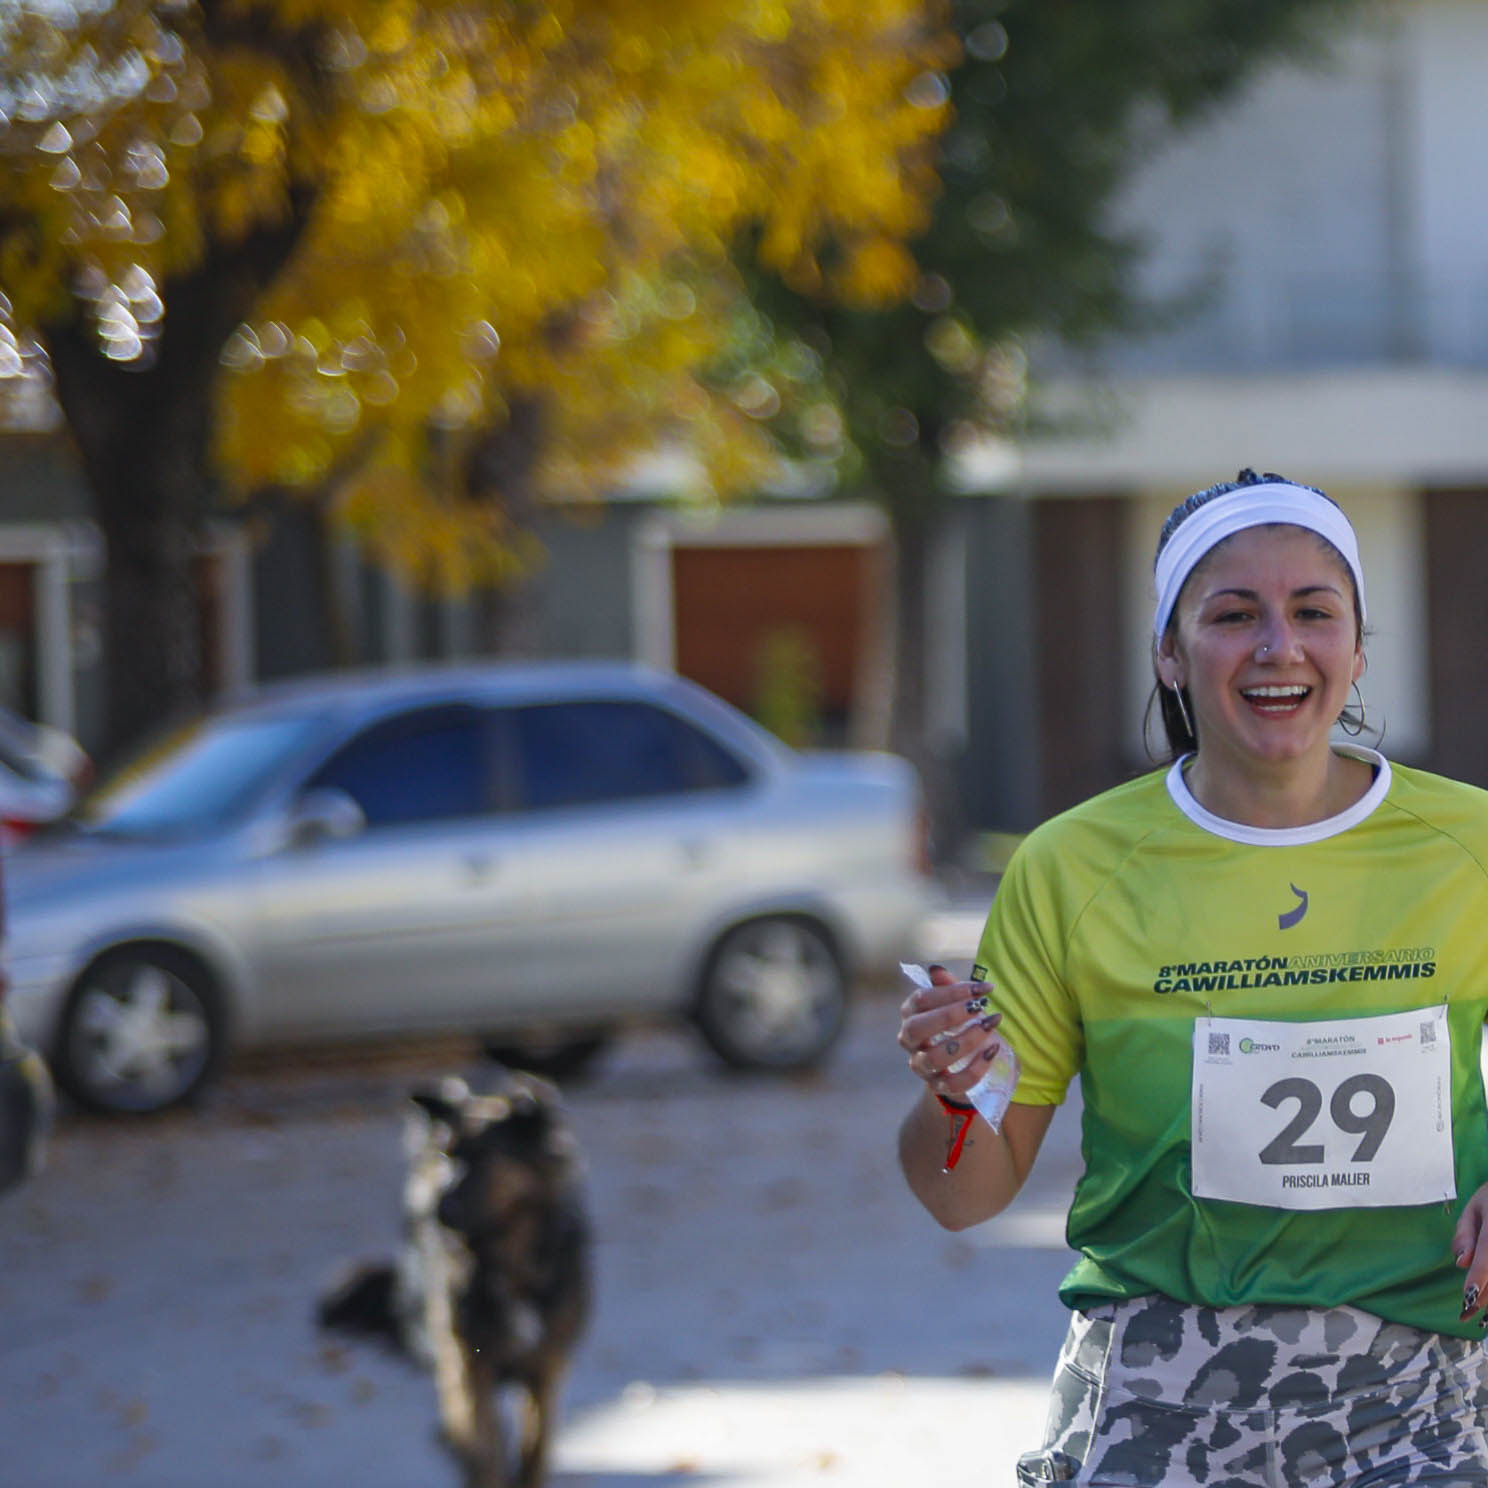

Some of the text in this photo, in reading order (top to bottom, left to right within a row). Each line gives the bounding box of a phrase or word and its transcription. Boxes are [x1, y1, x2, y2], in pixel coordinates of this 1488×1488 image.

[1153, 961, 1437, 995] CAWILLIAMSKEMMIS
[1258, 1072, 1396, 1165] 29
[1281, 1173, 1329, 1189] PRISCILA
